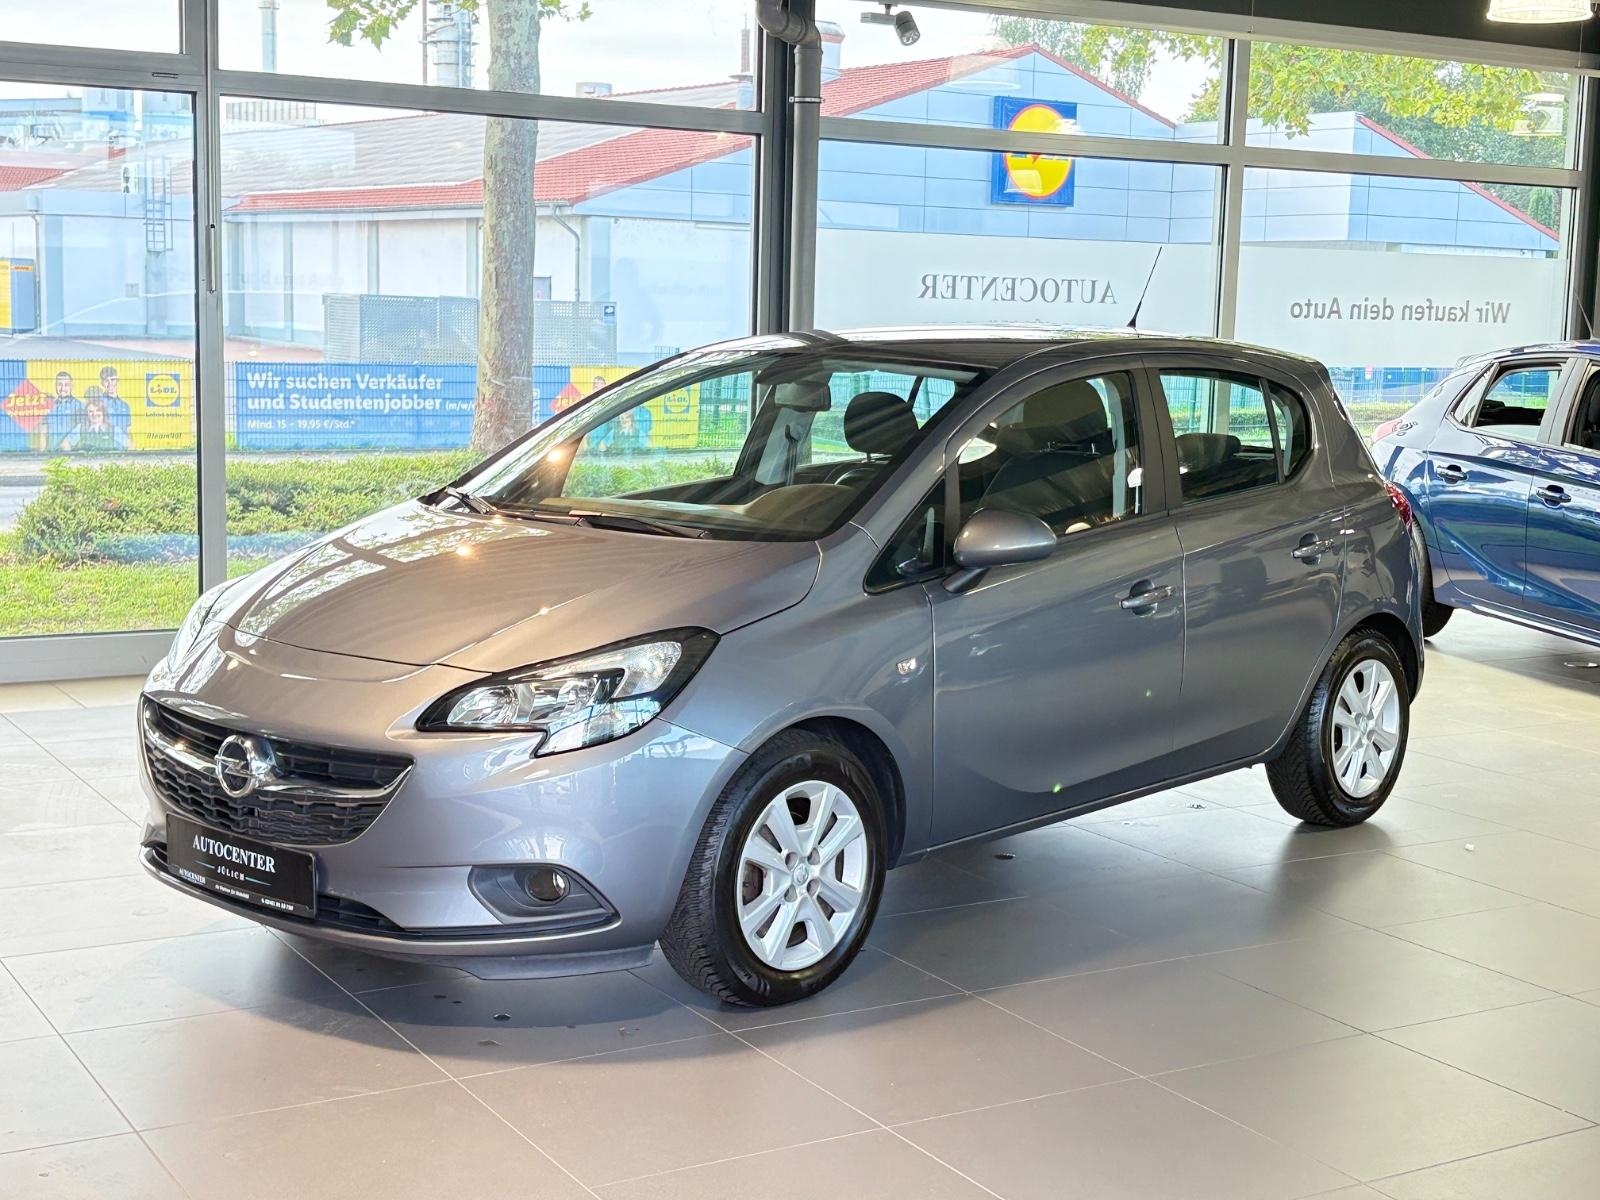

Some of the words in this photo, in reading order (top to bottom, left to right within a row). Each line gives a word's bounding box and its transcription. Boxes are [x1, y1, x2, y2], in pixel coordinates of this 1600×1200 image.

[247, 372, 282, 390] Wir
[286, 372, 352, 390] suchen
[355, 373, 444, 391] Verkäufer
[247, 393, 285, 410] und
[289, 394, 442, 414] Studentenjobber
[192, 833, 276, 873] AUTOCENTER
[216, 865, 245, 881] JÜLICH
